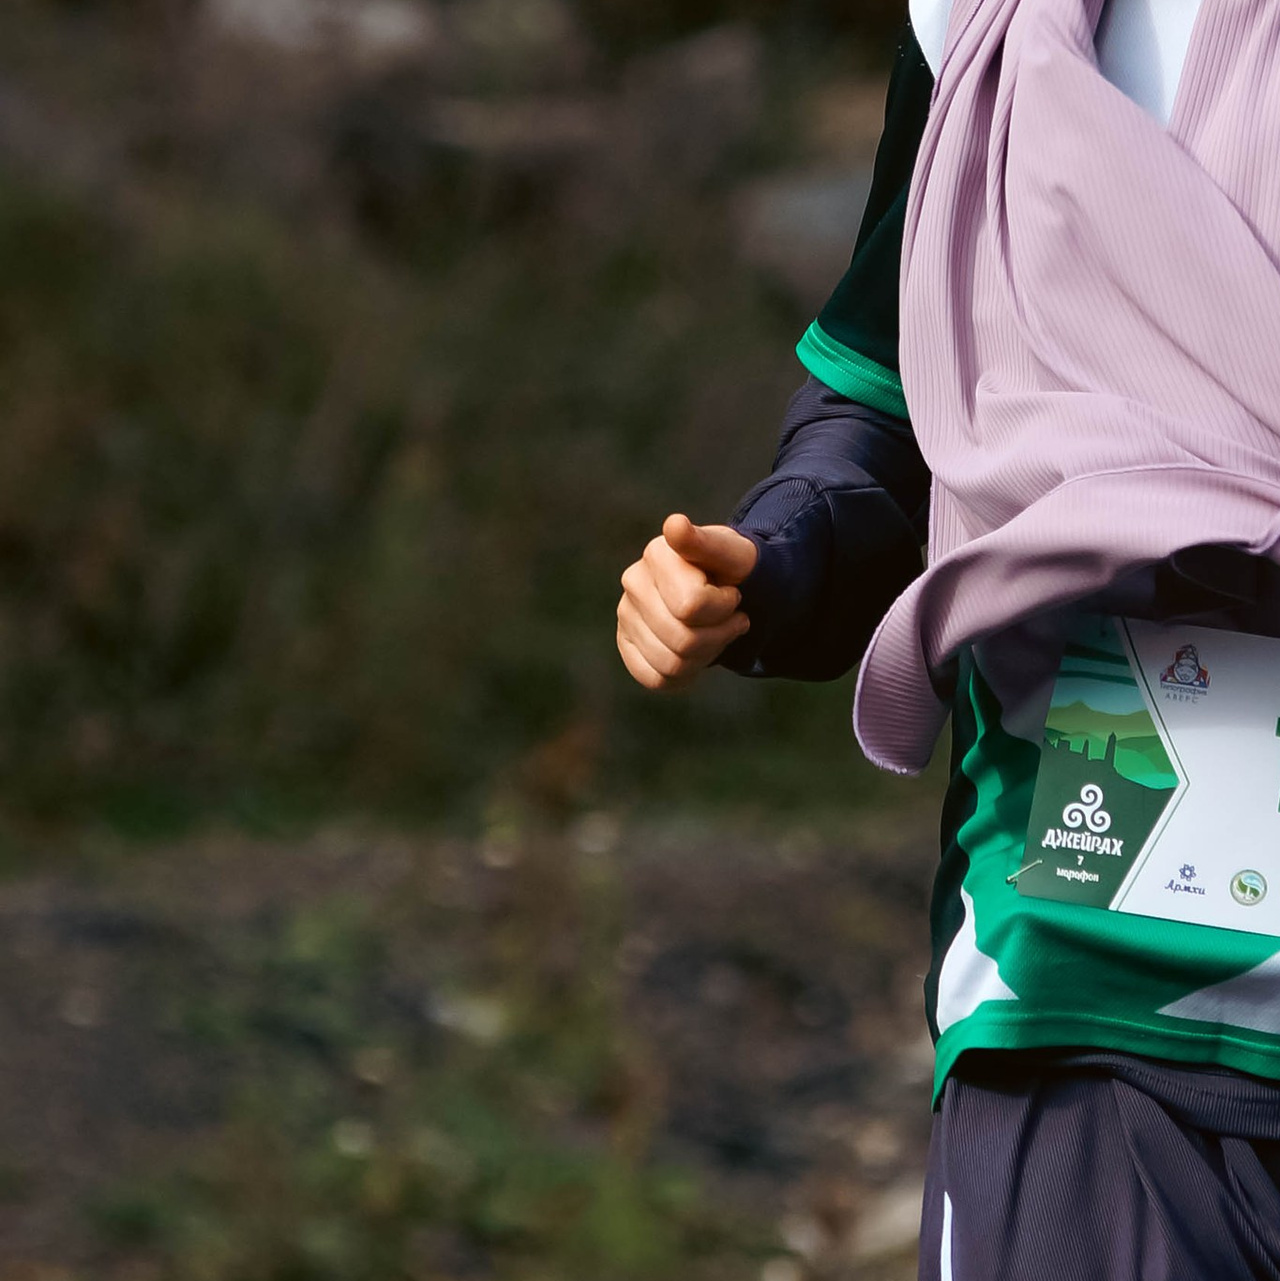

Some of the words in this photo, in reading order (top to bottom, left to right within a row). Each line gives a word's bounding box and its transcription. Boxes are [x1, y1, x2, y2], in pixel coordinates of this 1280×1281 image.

[1041, 828, 1124, 856] ДЖЕЙРАХ
[1077, 854, 1084, 866] 7
[1164, 879, 1206, 895] Армхи
